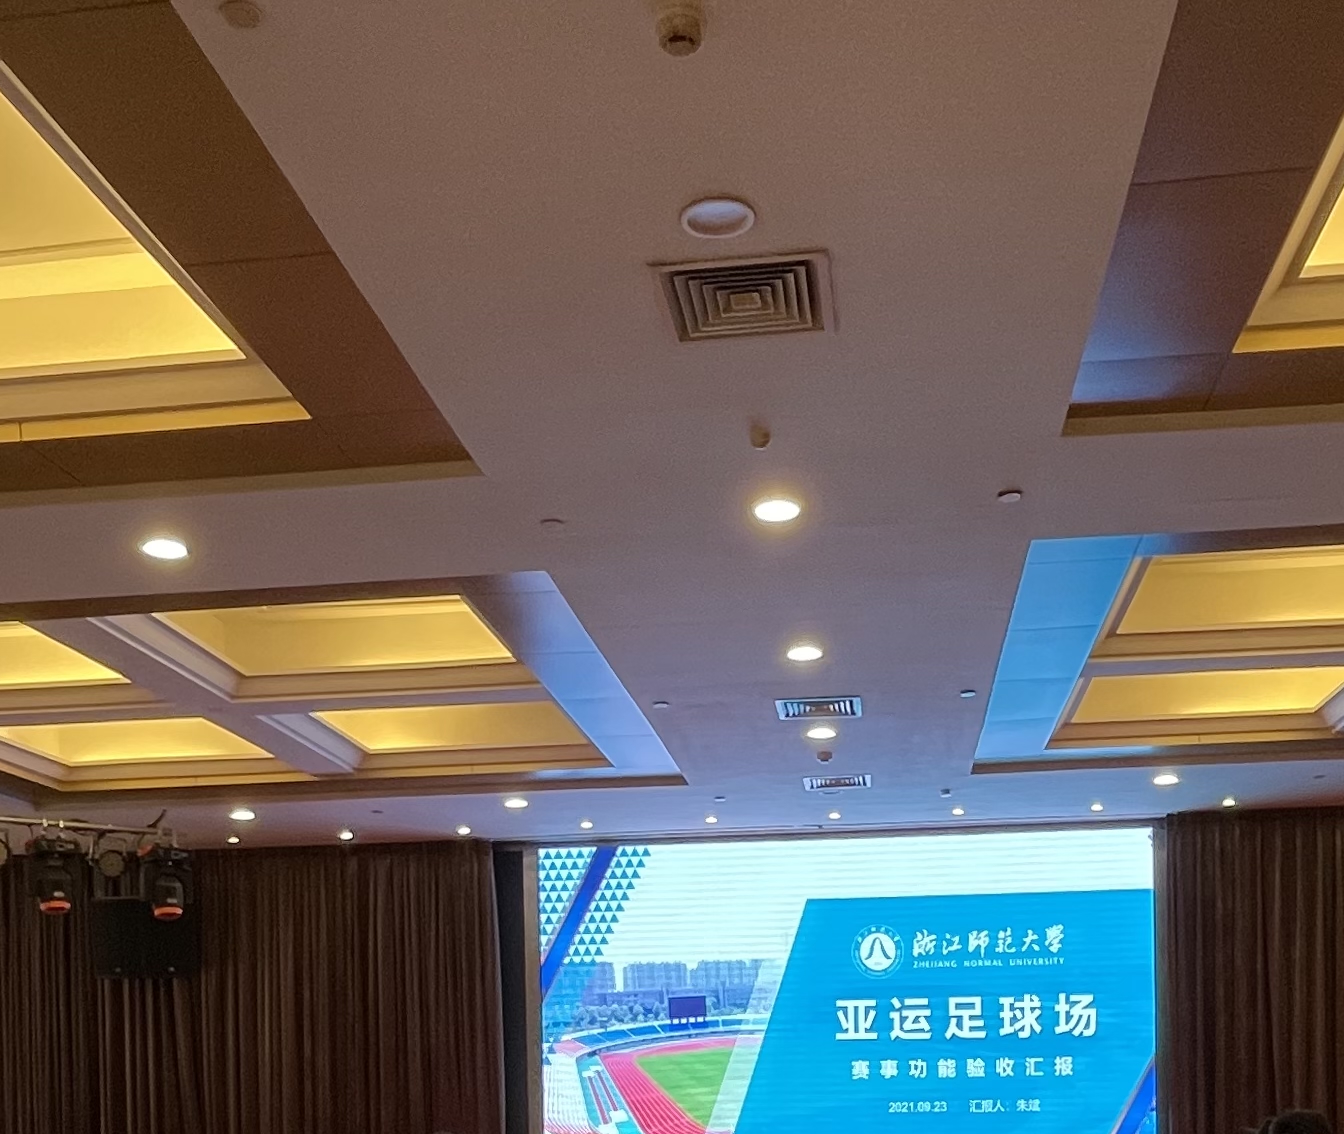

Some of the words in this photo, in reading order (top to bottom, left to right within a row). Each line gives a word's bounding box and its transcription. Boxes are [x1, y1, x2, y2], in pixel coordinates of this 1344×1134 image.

[963, 959, 1004, 968] NORMAL
[1009, 957, 1065, 967] UNIVERSITY
[835, 993, 1098, 1041] 亚运足球场
[851, 1056, 1074, 1080] 赛事功能验收汇报
[888, 1101, 948, 1113] 2021.09.23
